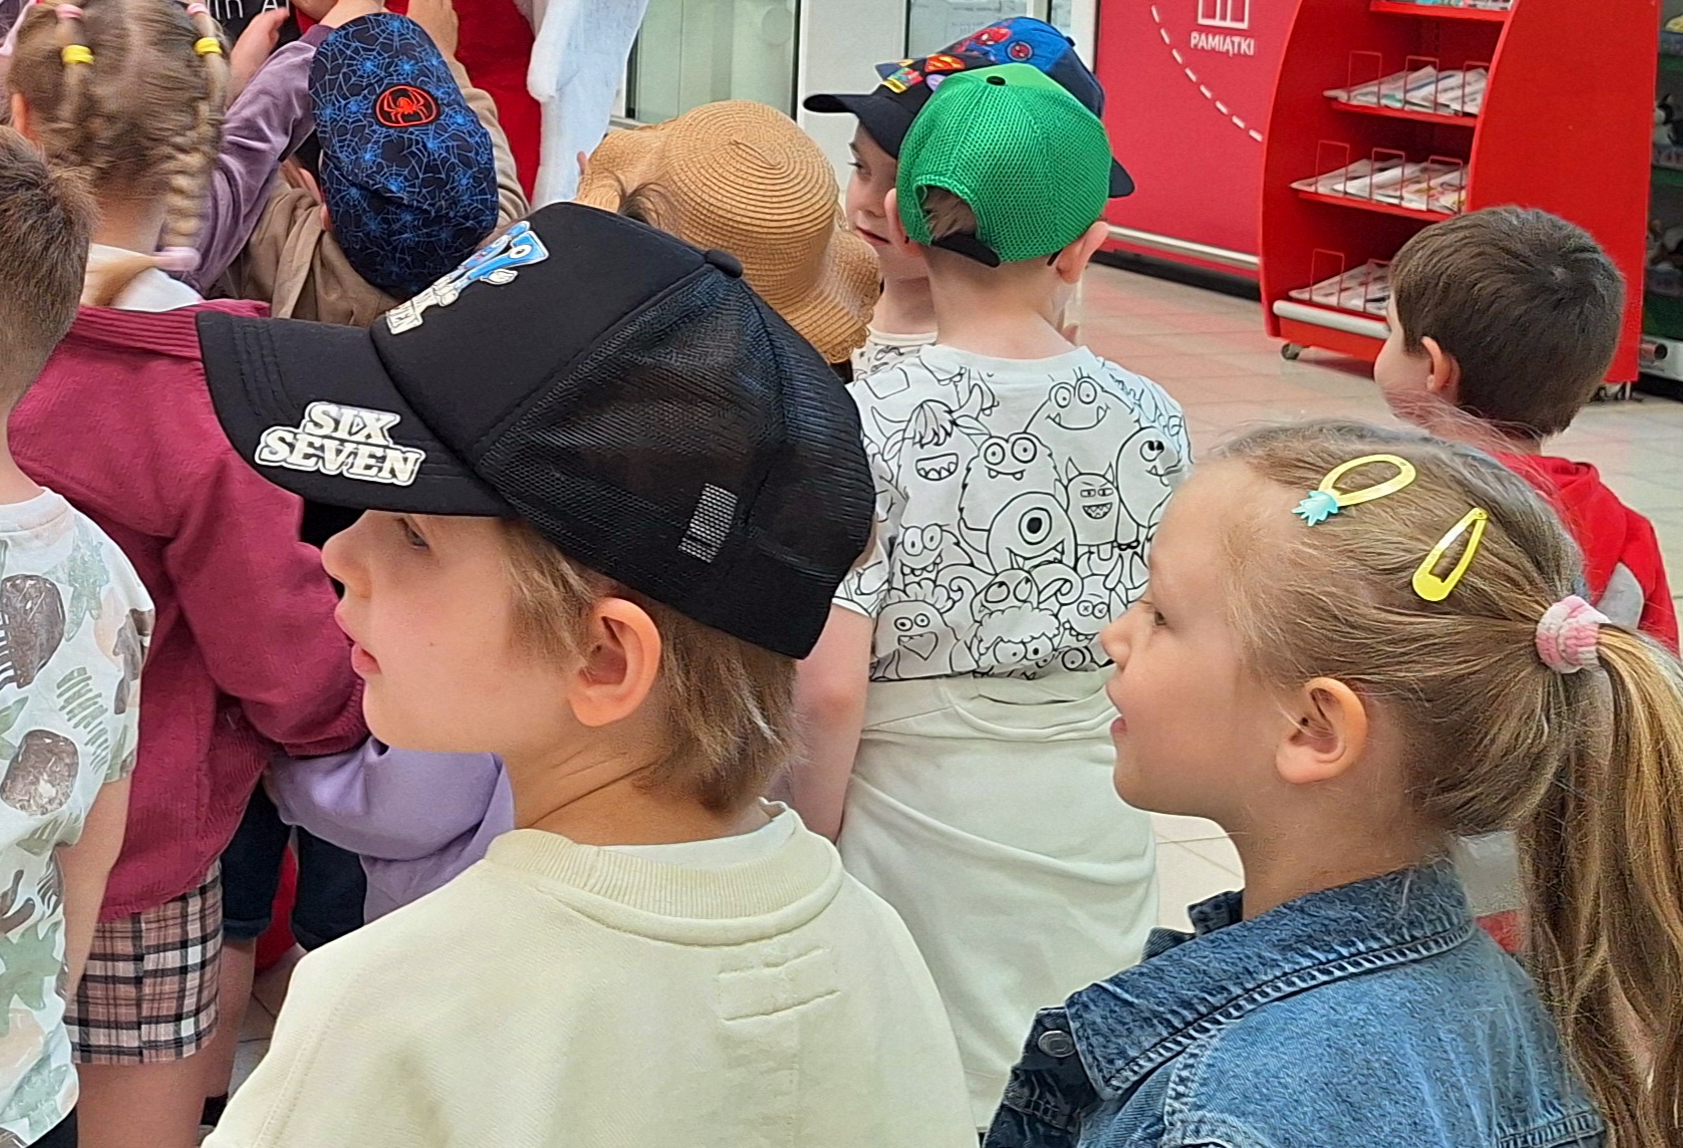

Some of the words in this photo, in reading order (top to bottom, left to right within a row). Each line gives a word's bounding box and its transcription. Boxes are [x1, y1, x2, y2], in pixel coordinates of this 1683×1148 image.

[1190, 30, 1255, 57] PAMIĄTKI
[306, 403, 399, 445] SIX
[257, 427, 424, 484] SEVEN
